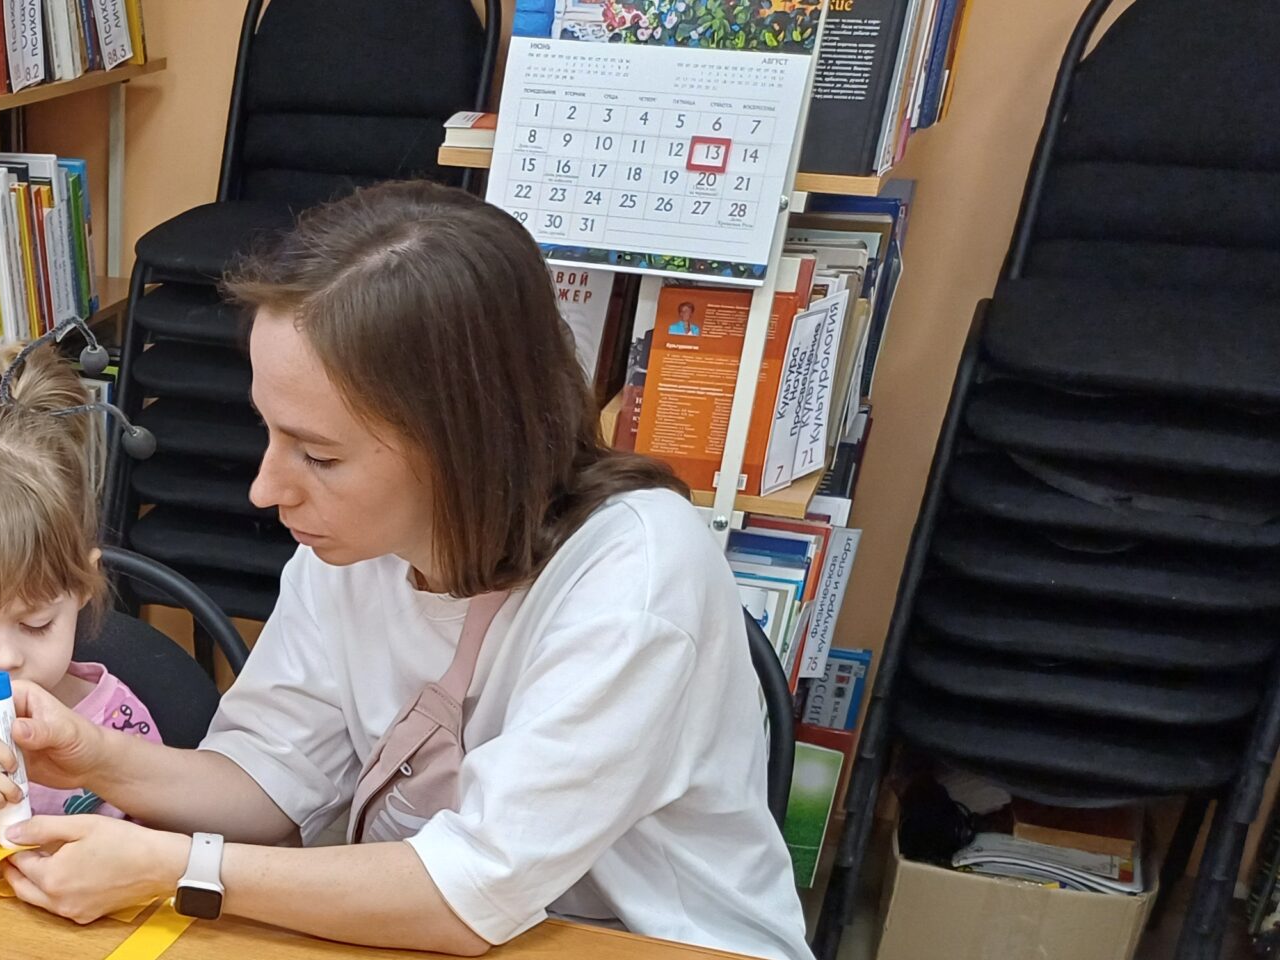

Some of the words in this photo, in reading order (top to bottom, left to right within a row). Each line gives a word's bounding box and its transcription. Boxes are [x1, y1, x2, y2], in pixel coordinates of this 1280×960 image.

[26, 64, 40, 82] 8.2
[761, 57, 789, 66] АВГУСТ
[534, 103, 540, 118] 1
[566, 105, 577, 120] 2
[602, 108, 613, 123] 3
[639, 111, 649, 126] 4
[675, 113, 686, 129] 5
[711, 116, 723, 132] 6
[750, 119, 762, 135] 7
[527, 129, 537, 143] 8
[562, 132, 573, 147] 9
[595, 136, 613, 151] 10
[632, 139, 646, 154] 11
[668, 142, 684, 157] 12
[705, 145, 721, 160] 13
[742, 148, 759, 163] 14
[521, 157, 537, 172] 15
[556, 160, 571, 174] 16
[591, 163, 608, 178] 17
[626, 166, 642, 181] 18
[663, 170, 679, 185] 19
[696, 172, 717, 187] 20
[734, 176, 751, 191] 21
[514, 184, 532, 199] 22
[548, 187, 567, 202] 23
[584, 190, 602, 205] 24
[619, 194, 638, 208] 25
[654, 197, 673, 212] 26
[691, 200, 711, 215] 27
[728, 202, 747, 218] 28
[513, 211, 528, 224] 29
[544, 214, 563, 229] 30
[579, 217, 595, 232] 31
[556, 271, 589, 287] ВОЙ
[558, 288, 593, 304] ЖЕР
[809, 302, 840, 445] Культурология
[774, 465, 784, 484] 7
[836, 536, 853, 578] спорт
[811, 555, 838, 639] Физическая
[834, 581, 840, 590] и
[817, 593, 837, 653] культура
[807, 656, 818, 672] 75
